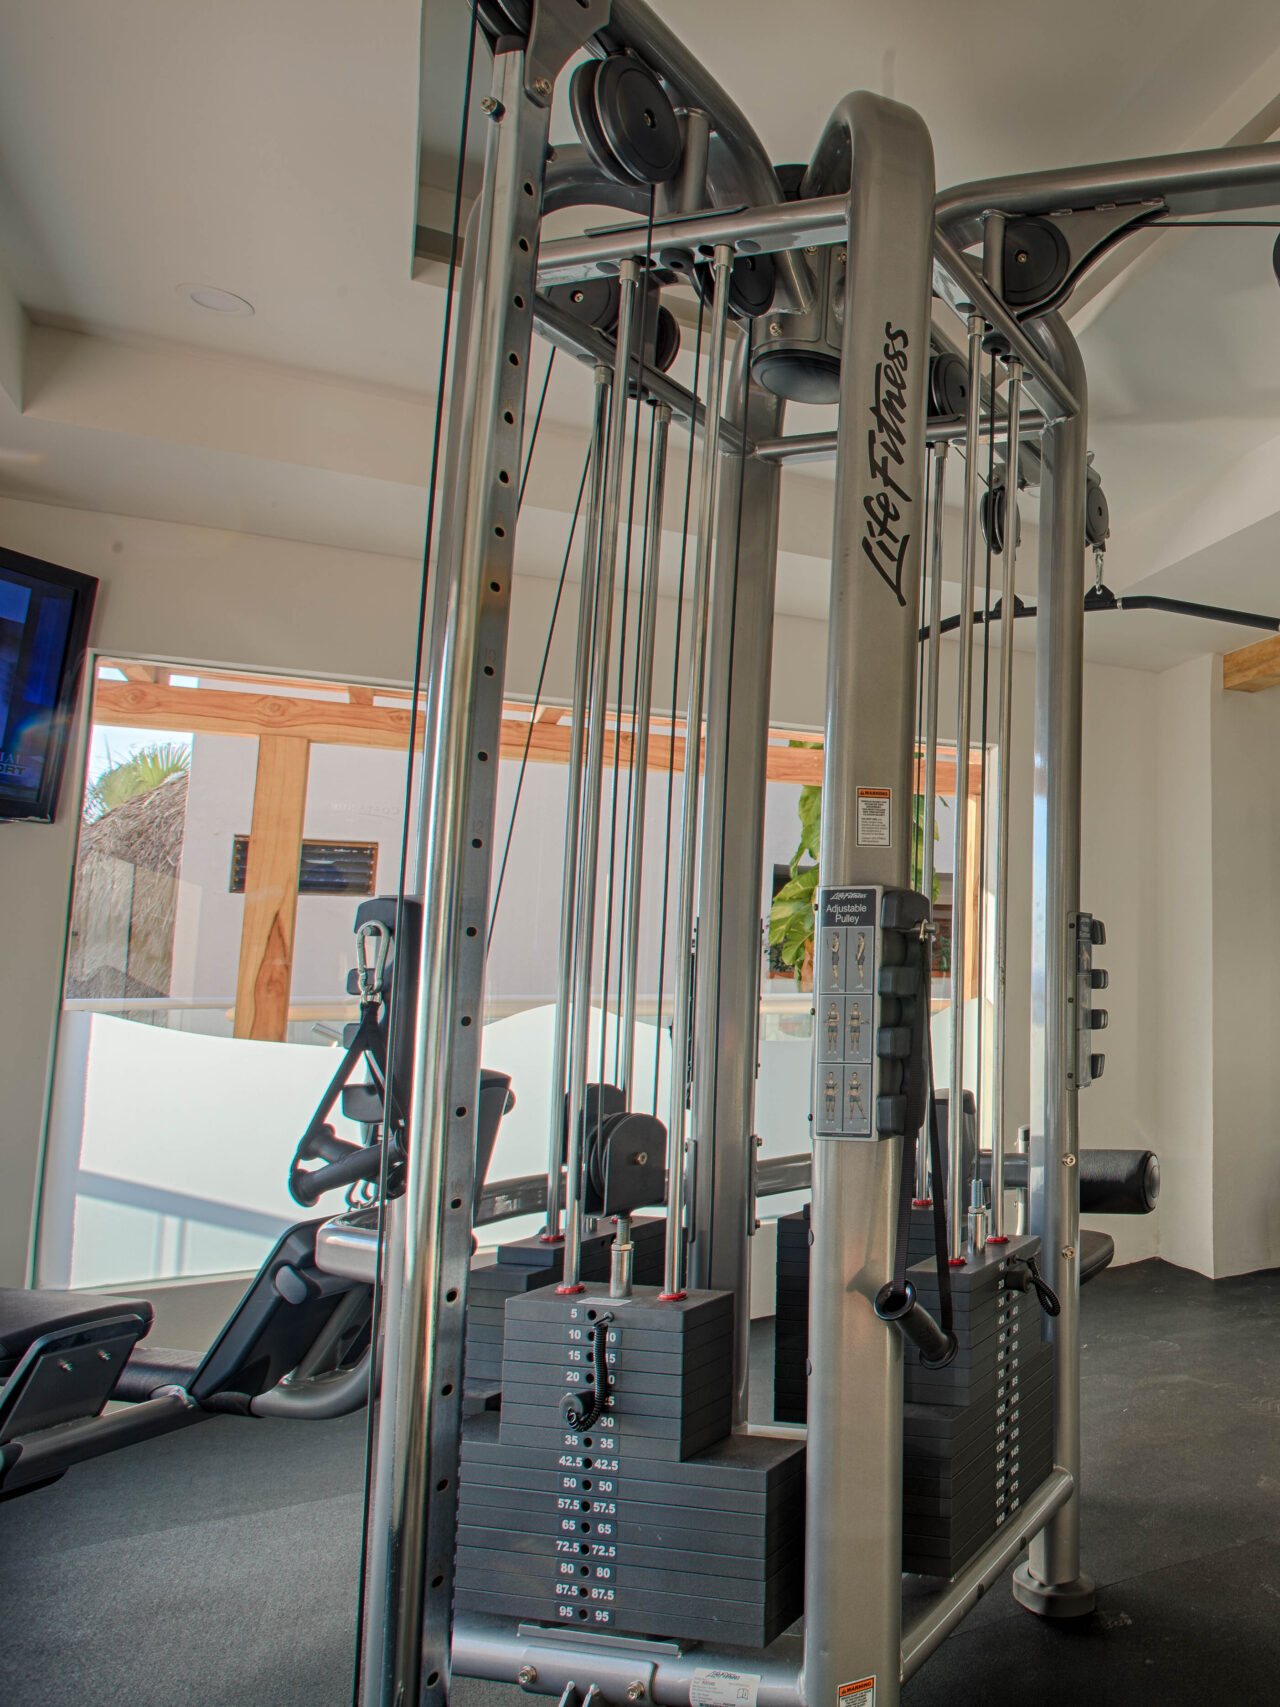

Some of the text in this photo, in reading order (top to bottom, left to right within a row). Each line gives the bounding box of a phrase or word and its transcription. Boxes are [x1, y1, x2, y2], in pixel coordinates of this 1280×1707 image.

[826, 904, 867, 915] Adjustable
[835, 914, 859, 925] Pulley
[570, 1309, 577, 1318] 5
[568, 1329, 581, 1340] 10
[568, 1350, 581, 1361] 15
[566, 1371, 615, 1385] 20 0
[601, 1417, 614, 1427] 30
[997, 1410, 1019, 1435] 115 115
[564, 1435, 614, 1450] 35 35
[558, 1455, 618, 1471] 42.5 42.5
[563, 1477, 612, 1493] 50 50
[558, 1498, 616, 1514] 57.5 57.5
[562, 1519, 611, 1535] 65 65
[556, 1540, 616, 1557] 72.5 72.5
[560, 1563, 610, 1579] 80 80
[555, 1583, 614, 1601] 87.5 87.5
[559, 1605, 609, 1622] 95 95
